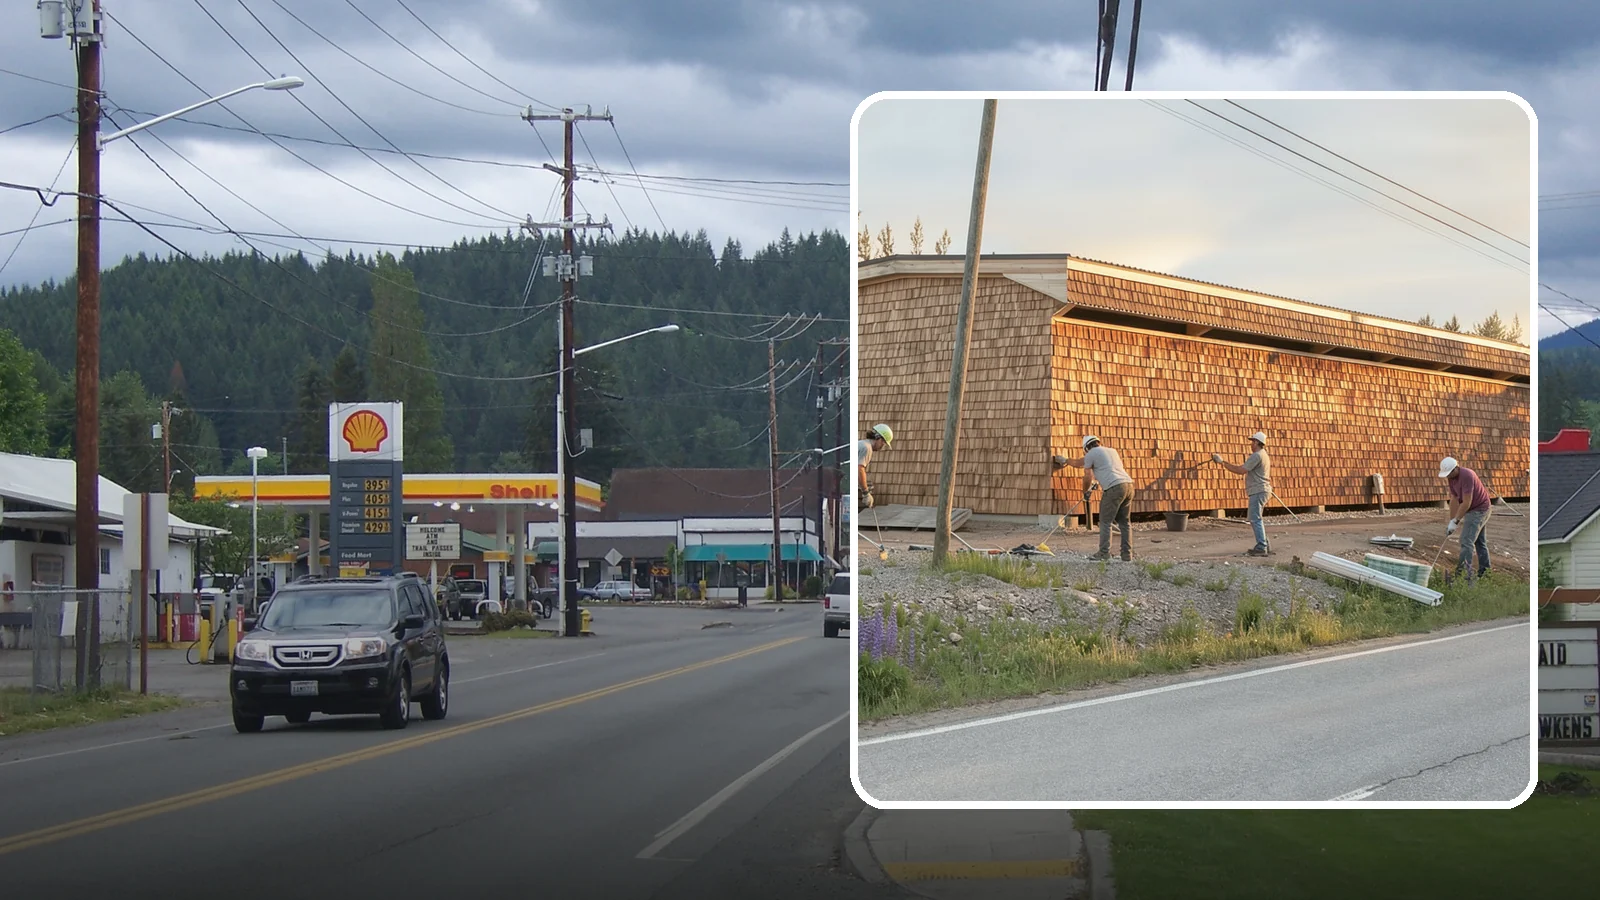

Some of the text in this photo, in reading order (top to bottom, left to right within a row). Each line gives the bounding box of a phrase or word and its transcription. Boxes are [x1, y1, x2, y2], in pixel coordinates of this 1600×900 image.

[366, 480, 384, 490] 395
[490, 484, 547, 498] Shell
[366, 494, 384, 504] 405
[366, 508, 383, 518] 415
[366, 522, 384, 532] 429
[1538, 642, 1566, 666] AID
